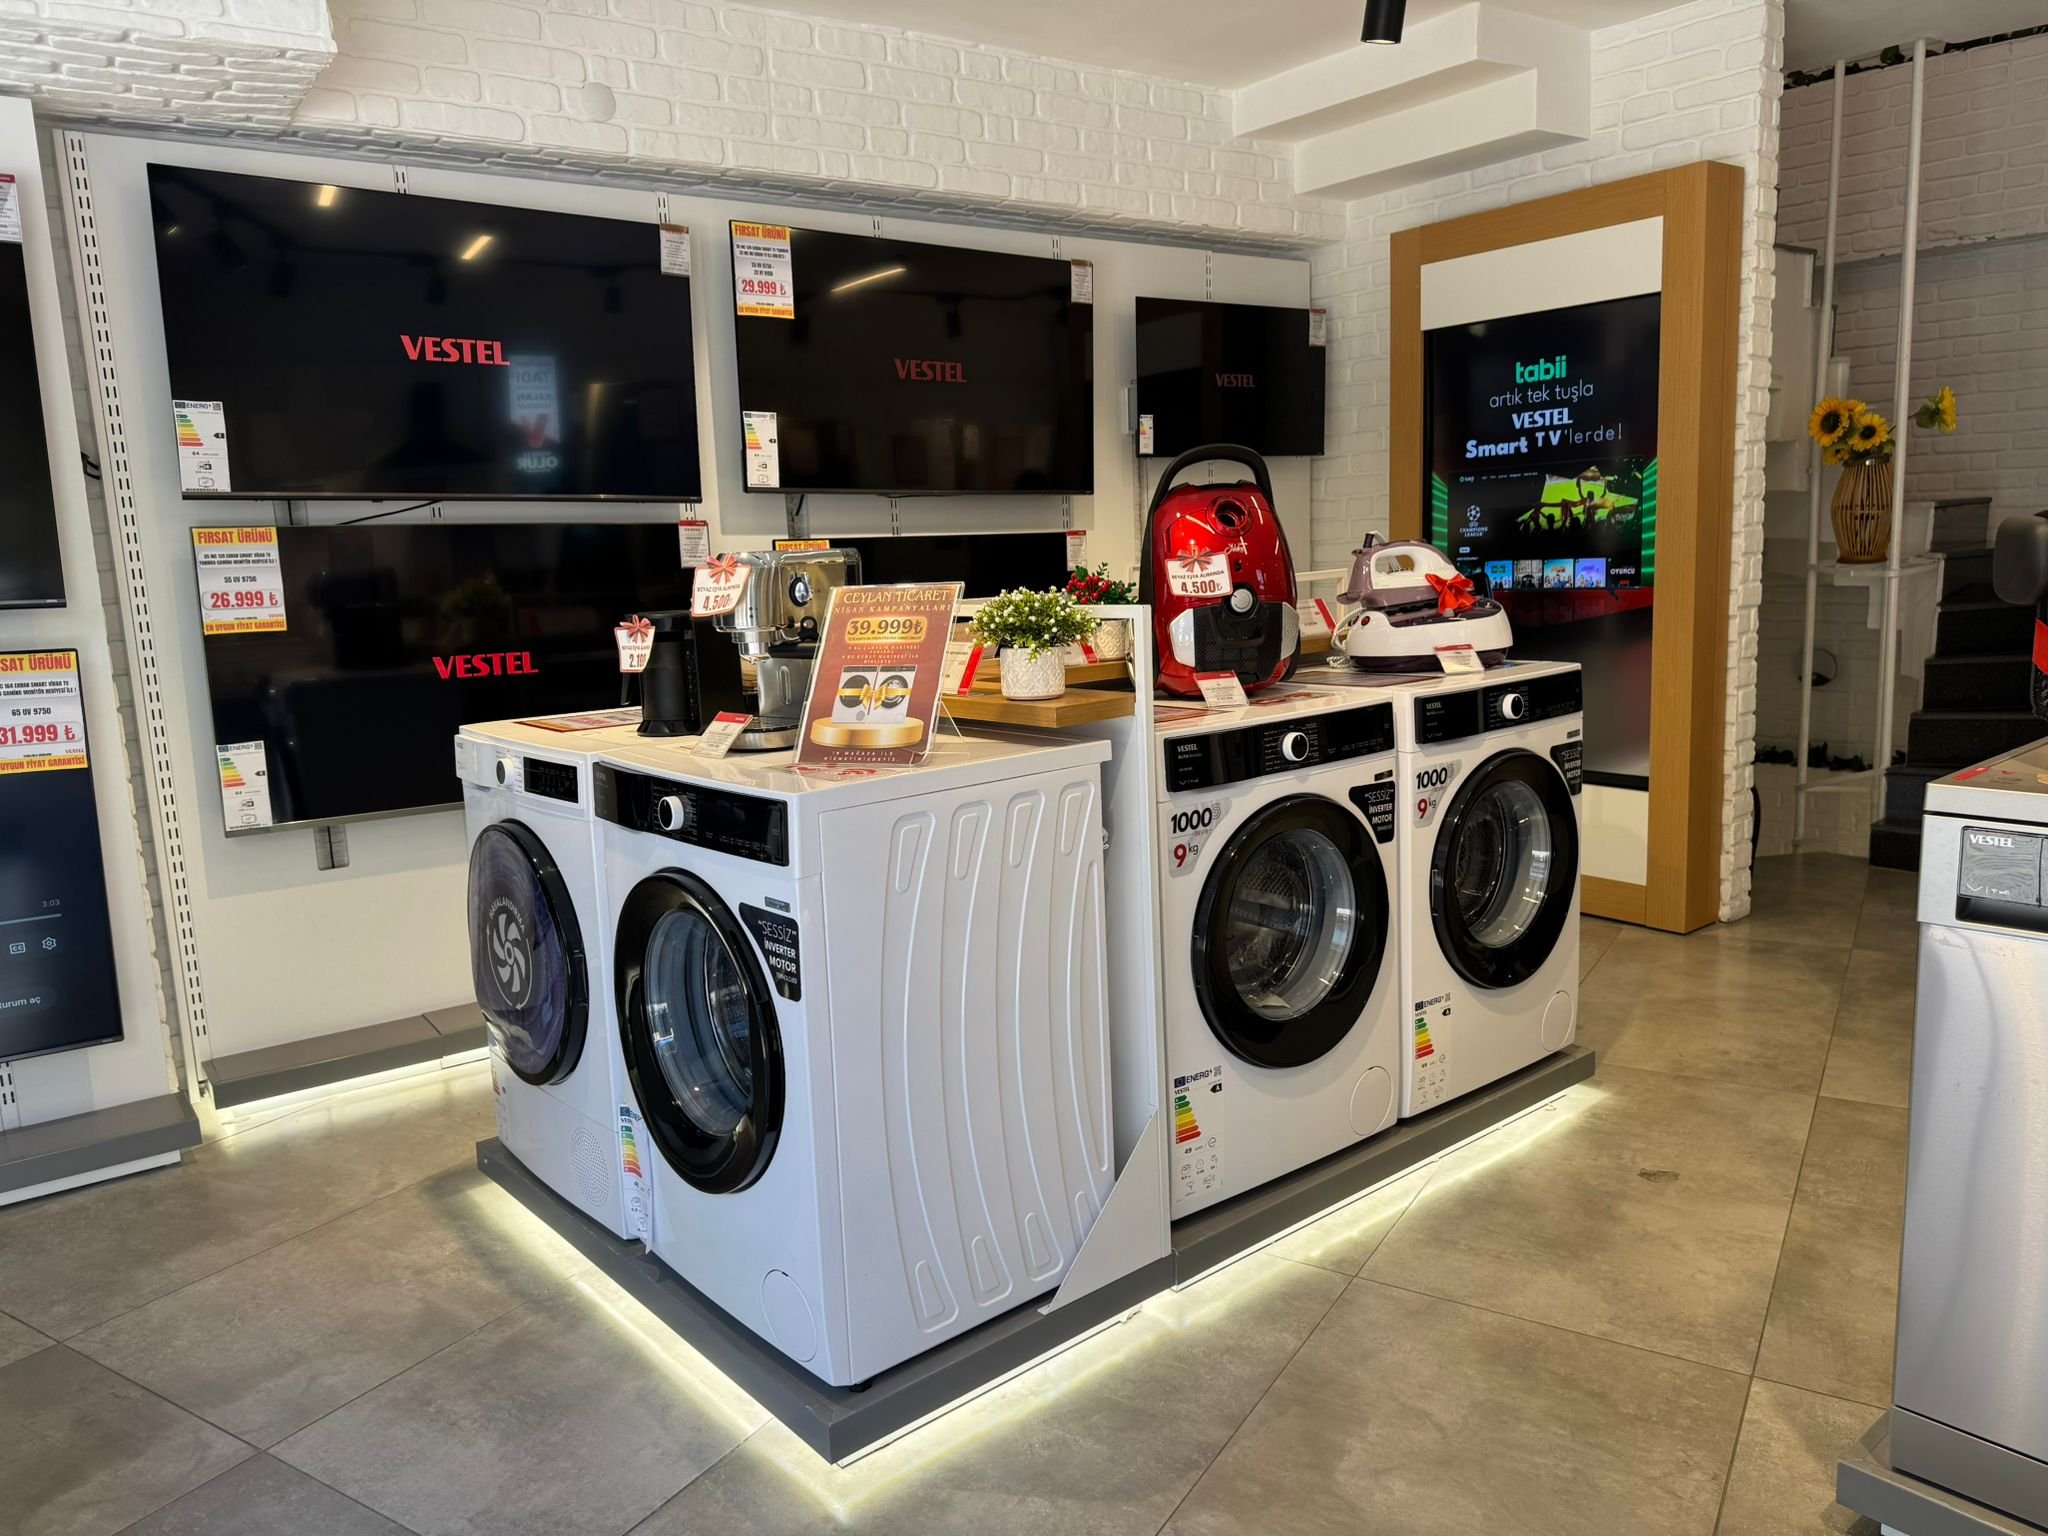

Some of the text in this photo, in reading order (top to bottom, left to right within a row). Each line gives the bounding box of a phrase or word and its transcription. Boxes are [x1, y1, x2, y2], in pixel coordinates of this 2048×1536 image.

[735, 225, 786, 240] FIRSAT ÜRÜNÜ
[741, 279, 786, 296] 29.999 ₺
[400, 334, 510, 366] VESTEL
[895, 358, 967, 383] VESTEL
[1515, 354, 1567, 384] tabii
[1215, 373, 1256, 388] VESTEL
[1489, 378, 1593, 408] artık tek tuşla
[1511, 407, 1573, 430] VESTEL
[1465, 436, 1528, 459] Smart
[197, 528, 273, 544] FIRSAT ÜRÜNÜ
[242, 575, 257, 583] 9750
[1610, 567, 1636, 575] OYUNCU
[210, 591, 278, 609] 26.999 ₺
[843, 589, 950, 604] CEYLAN TİCARET
[834, 604, 950, 615] NİSAN KAMPANYALARI
[847, 618, 923, 635] 39.999₺
[0, 653, 72, 672] SAT ÜRÜNÜ
[432, 651, 539, 679] VESTEL
[11, 707, 52, 716] 65 UV 9750
[0, 724, 76, 745] 31.999 ₺
[1176, 743, 1198, 753] VESTEL
[26, 758, 46, 769] FİYAT
[48, 756, 86, 767] GARANTİSİ
[1415, 767, 1448, 790] 1000
[1417, 798, 1437, 820] 9 kg
[1170, 807, 1213, 834] 1000
[1371, 813, 1393, 824] MOTOR
[1969, 834, 2015, 848] VESTEL
[1173, 843, 1199, 868] 9 kg
[489, 896, 525, 935] HAVALANDIRMA
[769, 955, 797, 974] MOTOR
[1424, 996, 1442, 1008] ENERG
[1186, 1069, 1209, 1084] ENERG
[1174, 1086, 1190, 1095] VESTEL
